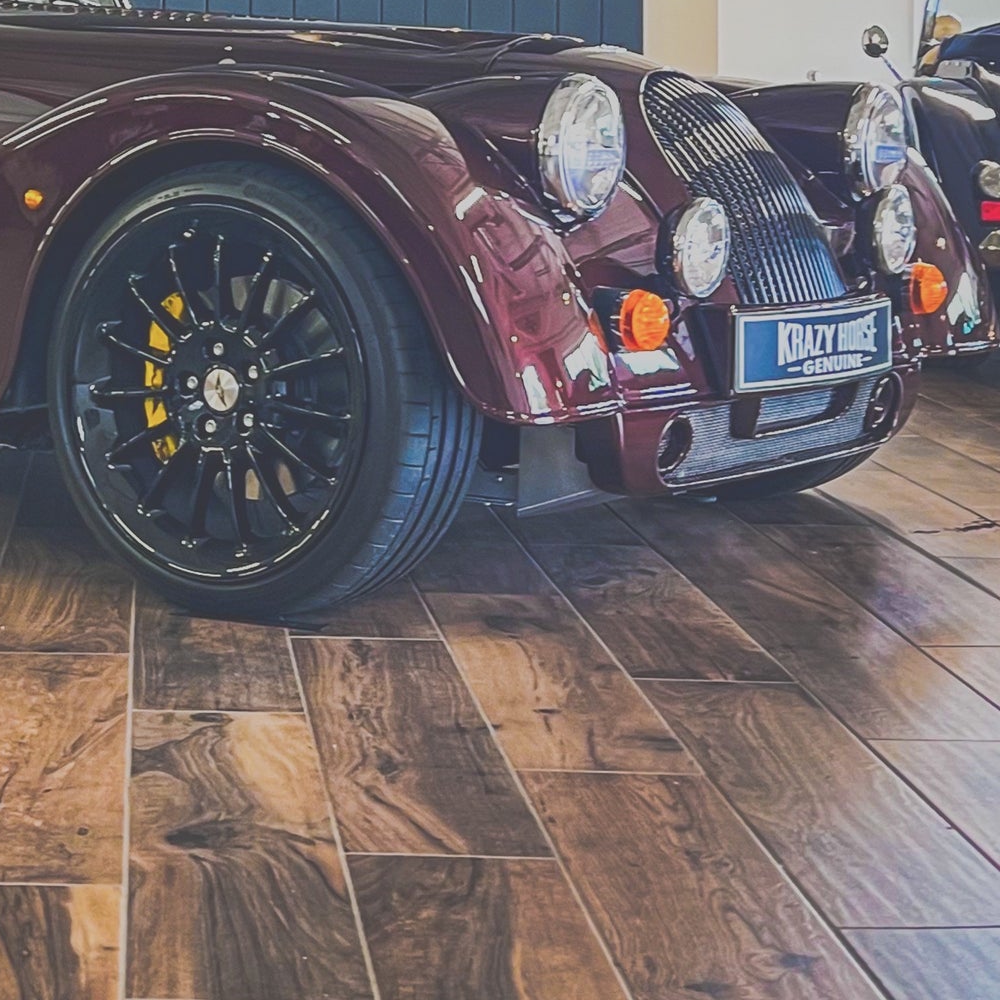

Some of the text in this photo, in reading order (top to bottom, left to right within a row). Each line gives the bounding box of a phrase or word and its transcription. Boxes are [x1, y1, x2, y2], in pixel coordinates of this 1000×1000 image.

[777, 310, 877, 366] KRAZY HORSE
[802, 353, 864, 375] GENUINE
